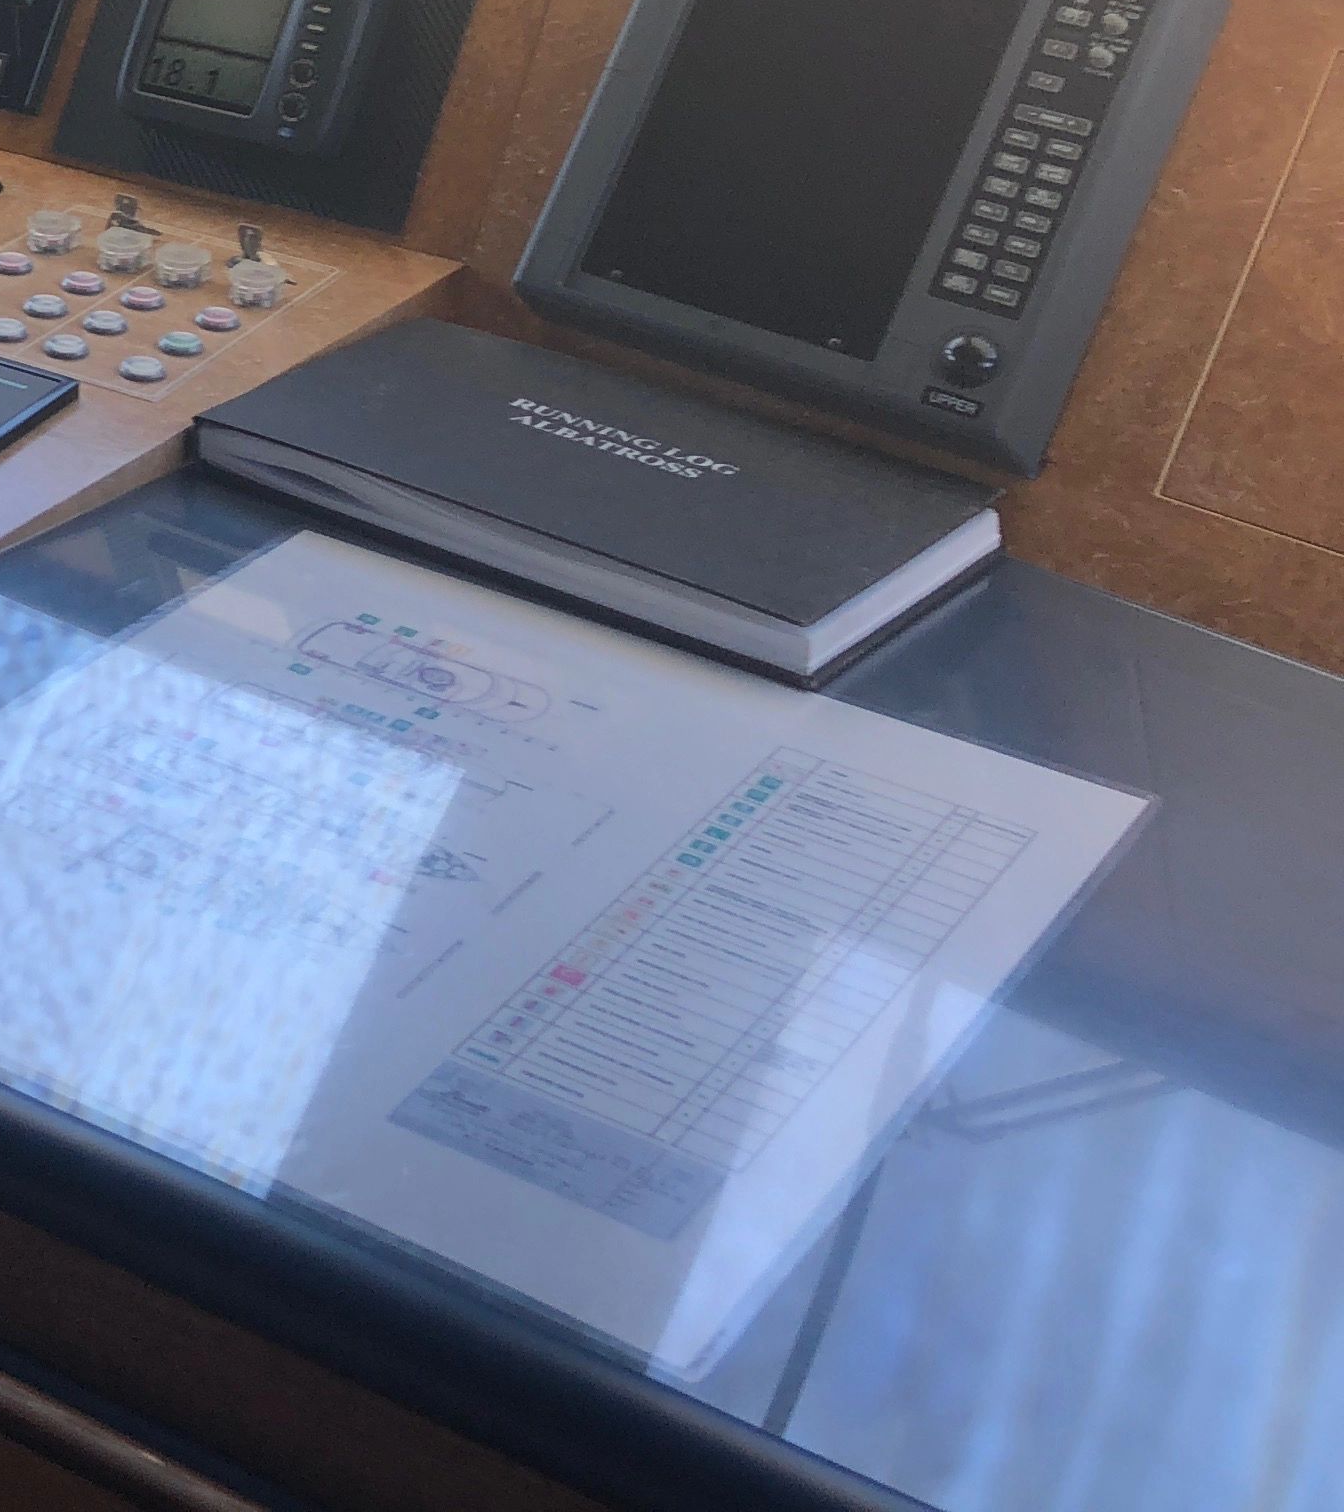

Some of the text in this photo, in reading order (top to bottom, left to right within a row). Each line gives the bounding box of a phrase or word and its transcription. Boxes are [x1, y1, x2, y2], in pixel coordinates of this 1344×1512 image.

[929, 391, 978, 415] UPPER
[509, 398, 740, 475] RUNNING LOG
[509, 415, 703, 478] ALBATROSS
